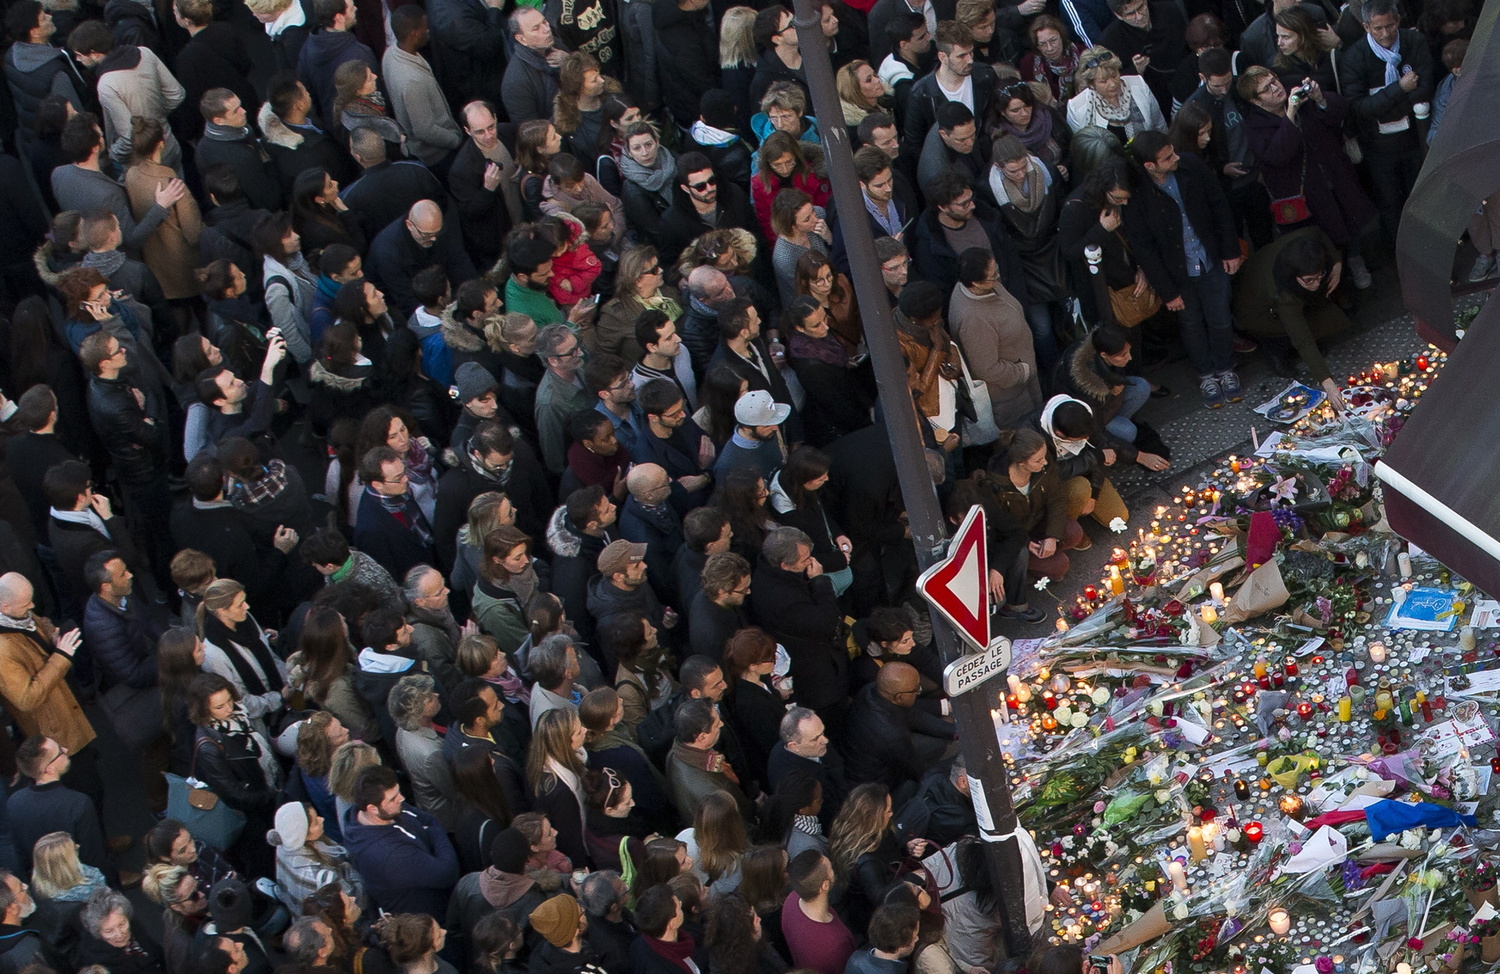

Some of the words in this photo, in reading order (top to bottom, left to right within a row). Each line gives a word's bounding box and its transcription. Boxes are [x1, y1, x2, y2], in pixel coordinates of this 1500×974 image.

[956, 655, 986, 678] CÉDEZ
[991, 646, 1003, 658] LE
[958, 658, 1003, 689] PASSAGE
